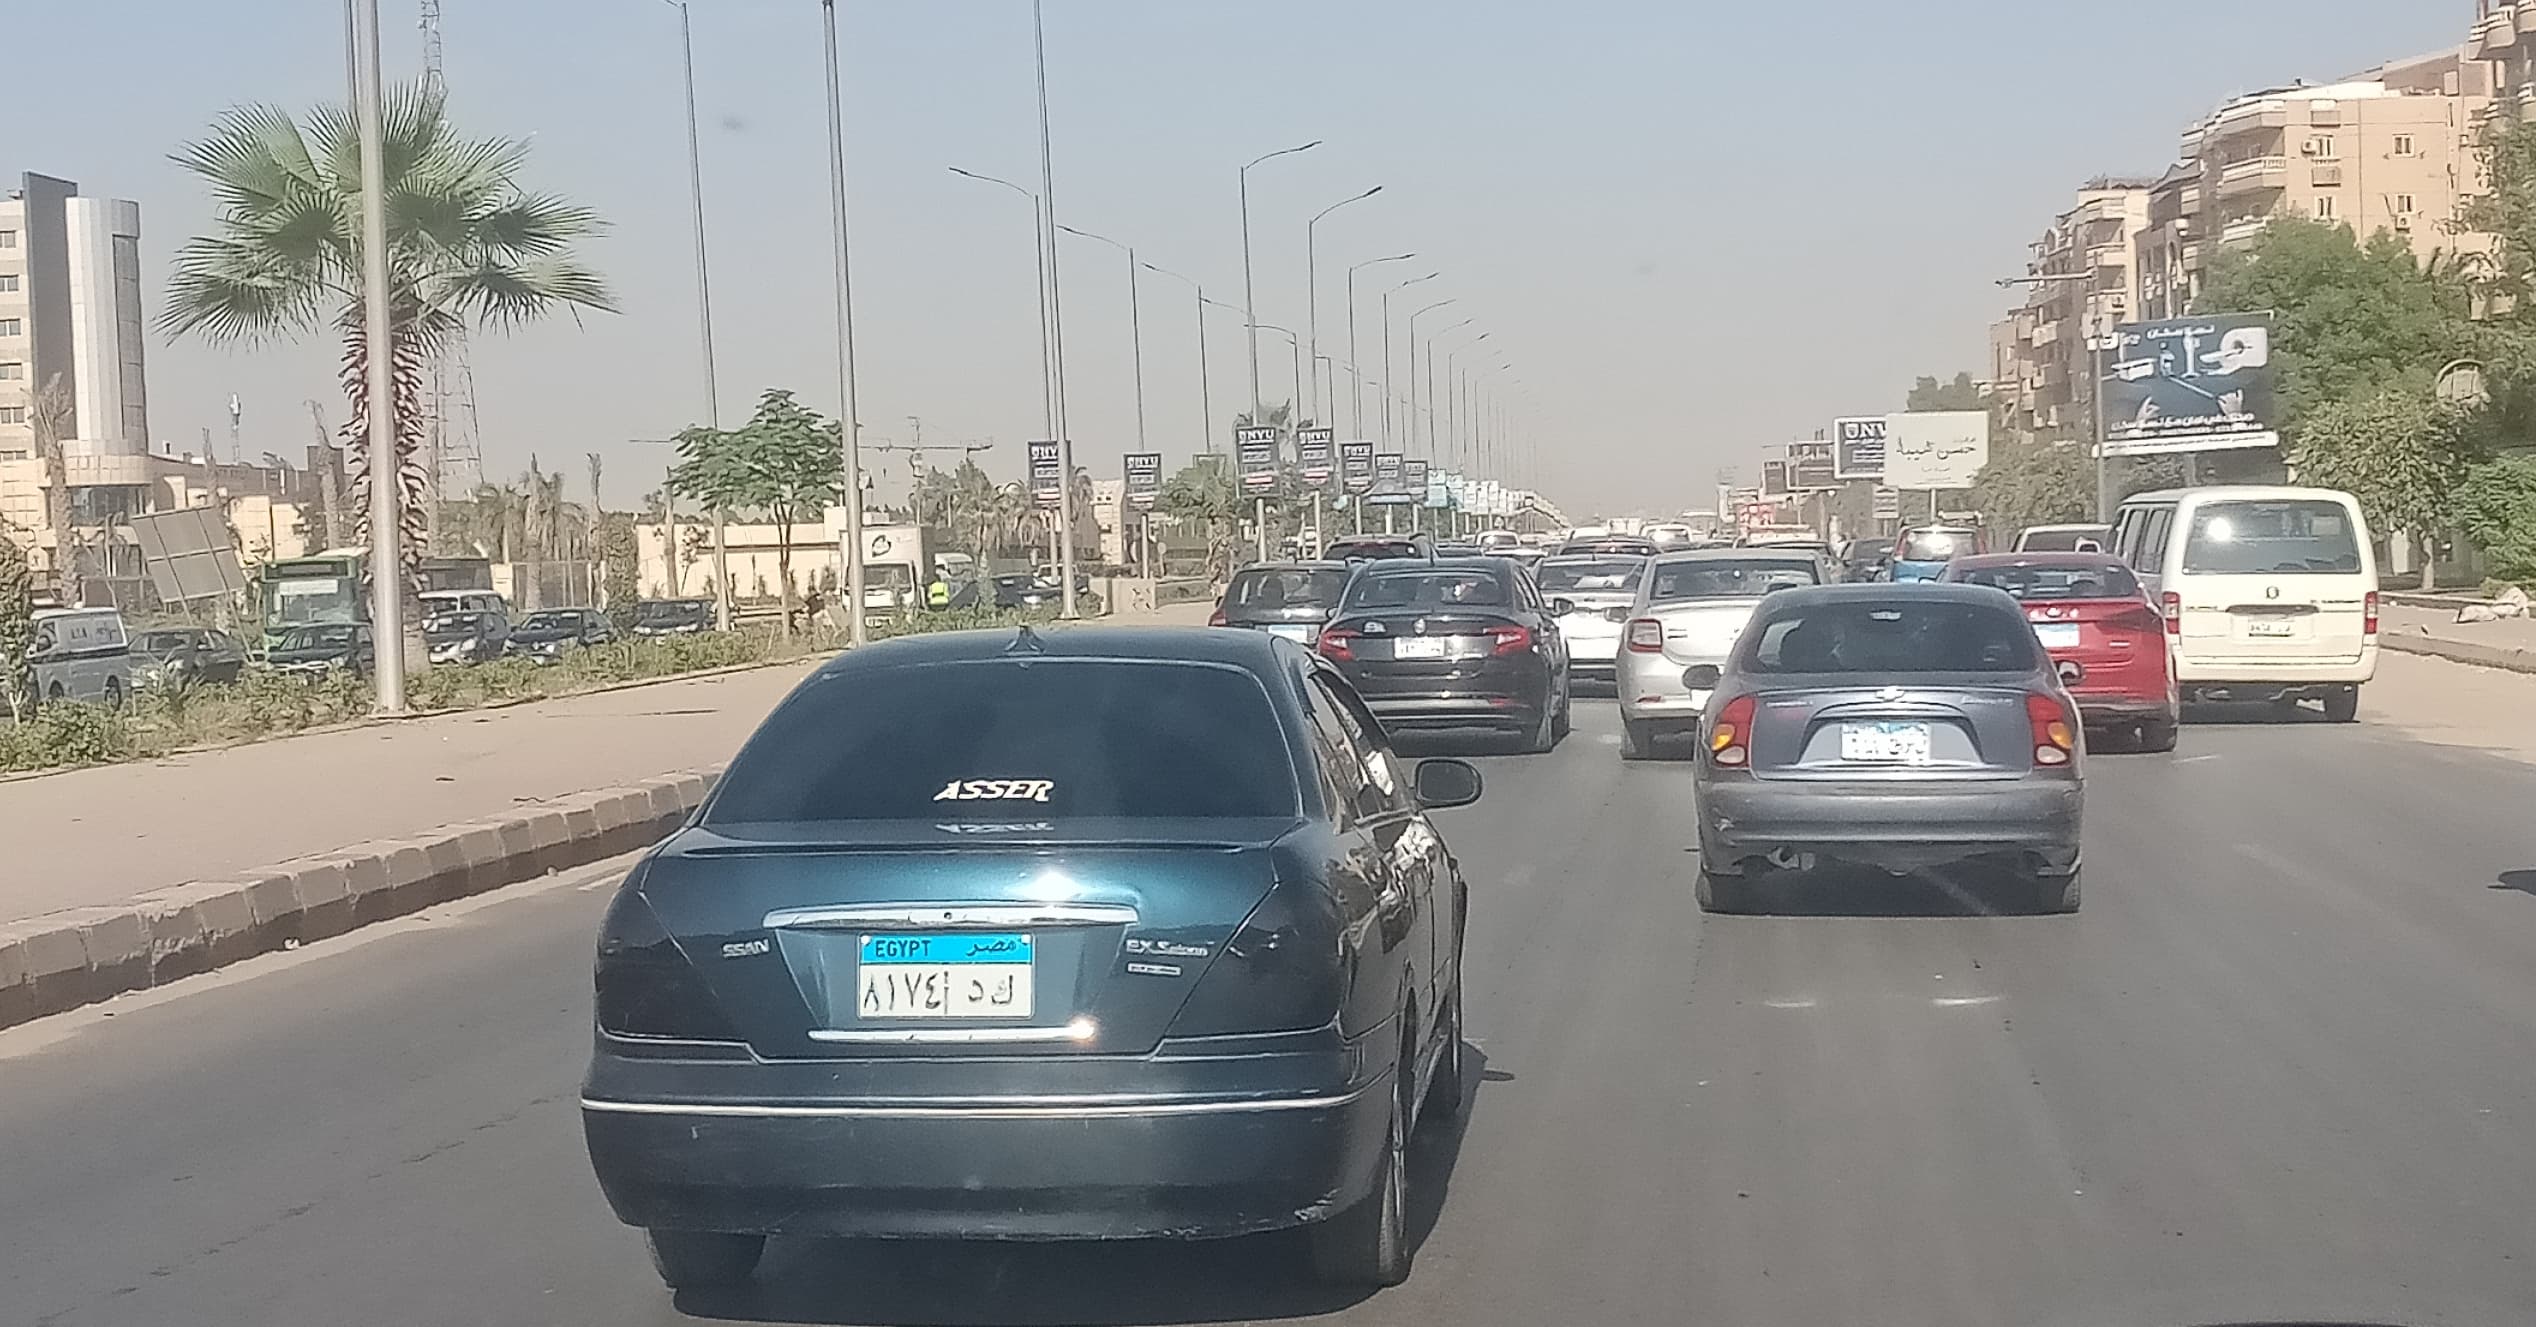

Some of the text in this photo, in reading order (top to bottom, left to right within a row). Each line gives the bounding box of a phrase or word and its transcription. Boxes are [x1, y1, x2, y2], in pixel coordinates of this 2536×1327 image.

[933, 780, 1054, 802] ASSER
[875, 939, 932, 957] EGYPT
[966, 939, 1017, 956] مصر
